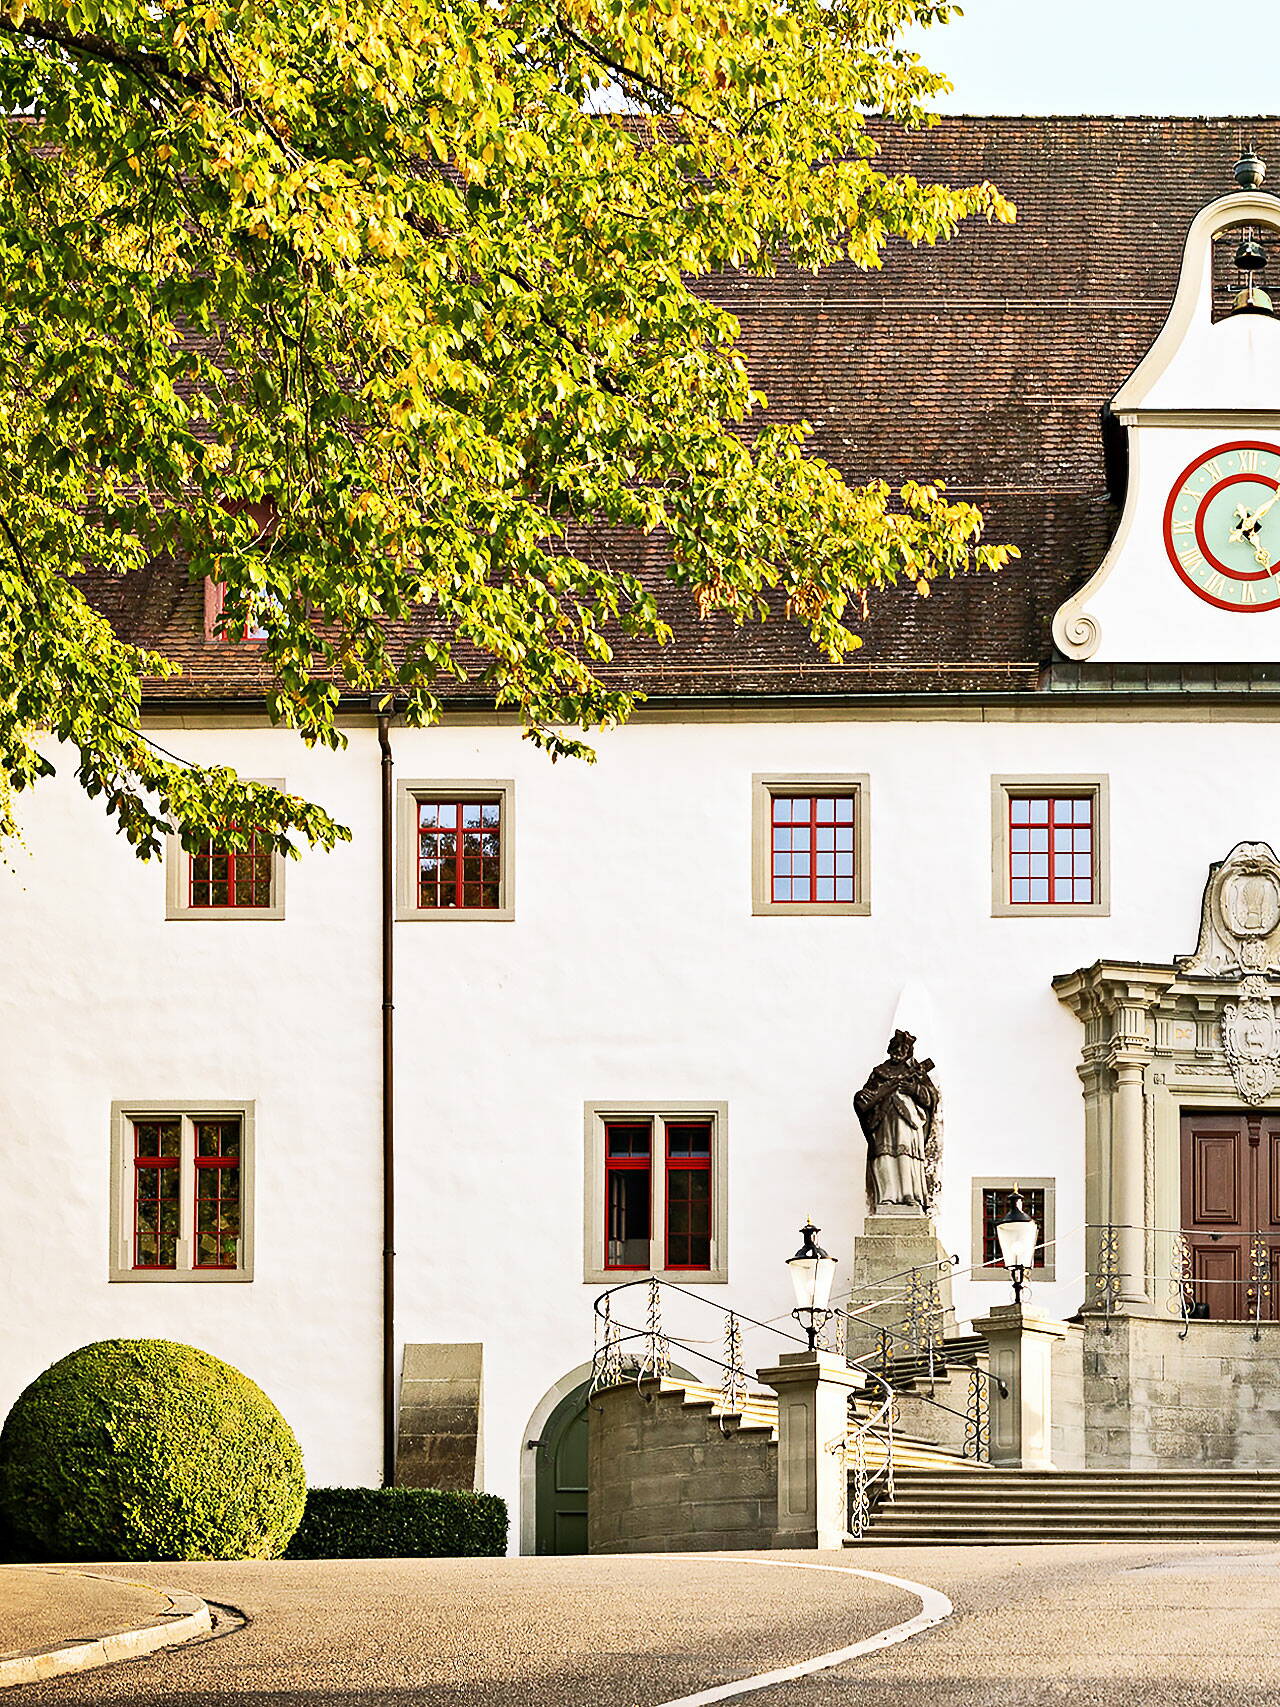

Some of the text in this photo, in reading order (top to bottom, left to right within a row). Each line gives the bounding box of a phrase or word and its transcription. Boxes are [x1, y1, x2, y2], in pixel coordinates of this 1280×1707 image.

[1201, 457, 1224, 482] XI
[1237, 450, 1261, 472] XII
[1180, 486, 1203, 504] X
[1172, 520, 1194, 535] IX
[1203, 570, 1227, 597] VII
[1240, 581, 1258, 604] VI
